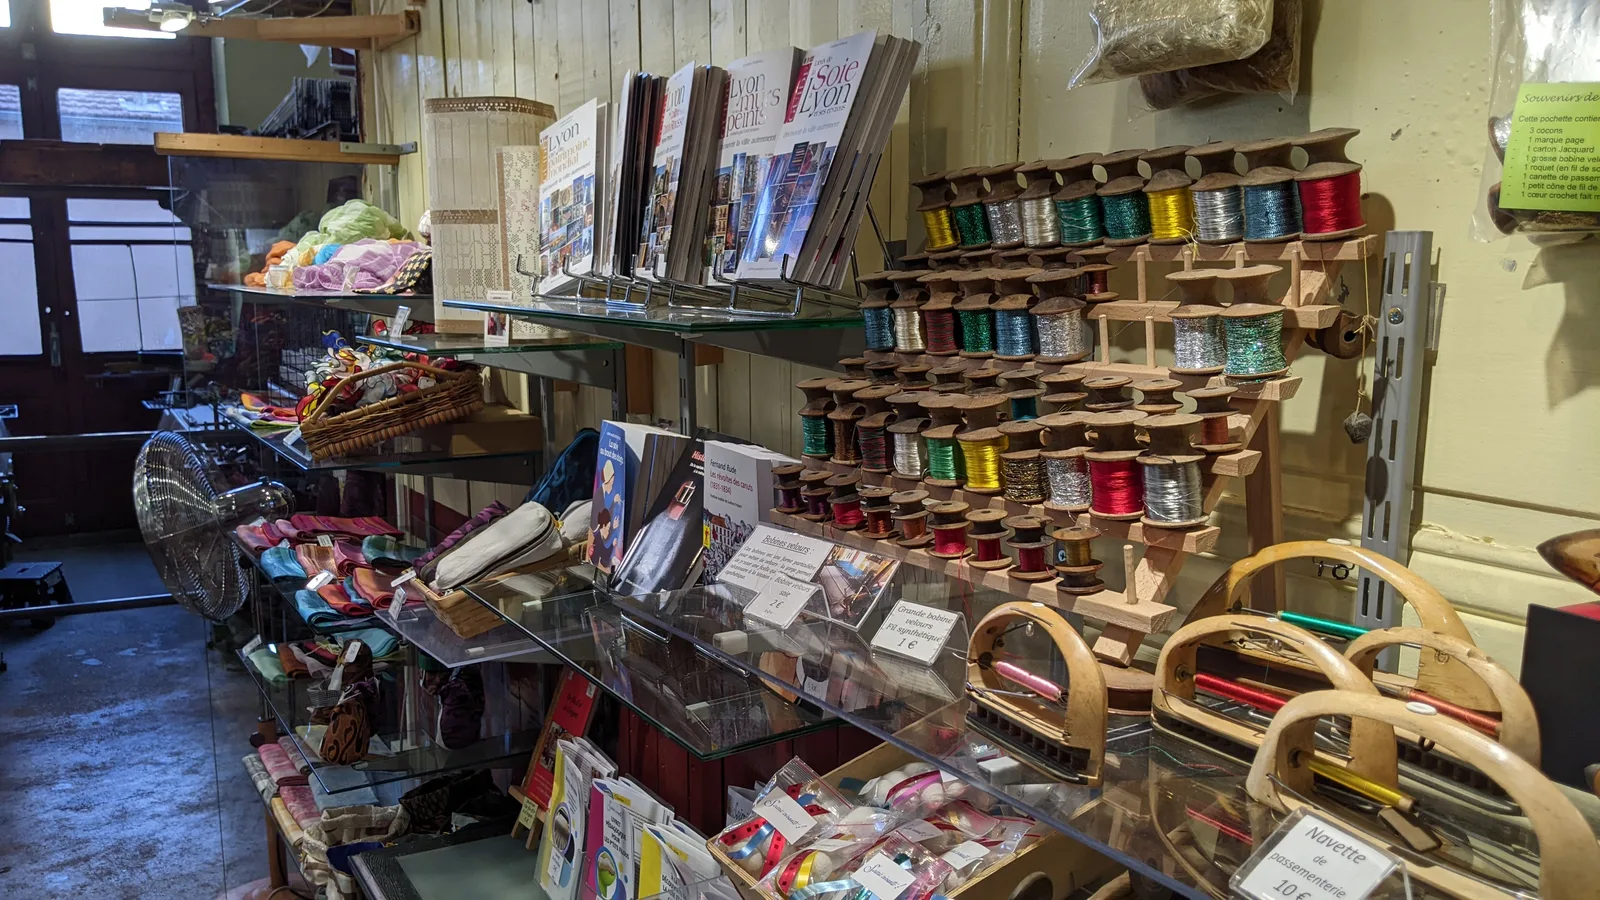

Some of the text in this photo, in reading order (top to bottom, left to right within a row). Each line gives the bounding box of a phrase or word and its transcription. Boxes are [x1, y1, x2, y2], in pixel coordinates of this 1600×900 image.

[812, 57, 859, 90] Soie
[730, 73, 766, 107] Lyon
[799, 77, 851, 118] Lyon
[1523, 92, 1600, 103] Souvenirs de
[666, 85, 686, 117] Lyon
[726, 108, 766, 138] peints
[1519, 115, 1539, 123] Cette
[1540, 115, 1573, 123] pochette
[549, 122, 580, 155] Lyon
[1534, 137, 1563, 145] marque
[1565, 137, 1585, 145] page
[1558, 146, 1595, 154] Jacquard
[1530, 164, 1555, 172] roquet
[1529, 173, 1557, 181] canette
[1528, 182, 1545, 190] petit
[1546, 182, 1565, 190] cône
[1549, 192, 1578, 200] crochet
[710, 459, 726, 471] Fernand
[727, 464, 737, 474] Rude
[717, 472, 733, 484] révoltes
[740, 482, 753, 492] canuts
[752, 547, 765, 556] bobines
[763, 535, 786, 548] Bobines
[786, 541, 810, 553] velours
[775, 576, 792, 587] Bobine
[792, 583, 811, 593] velours
[897, 605, 953, 624] Grande bobine
[885, 622, 943, 643] Fil synthétique
[905, 618, 934, 630] velours
[897, 638, 918, 650] 1 €
[1304, 826, 1366, 865] Navette
[1312, 855, 1327, 866] de
[1267, 852, 1346, 899] passementerie
[1272, 879, 1298, 896] 10
